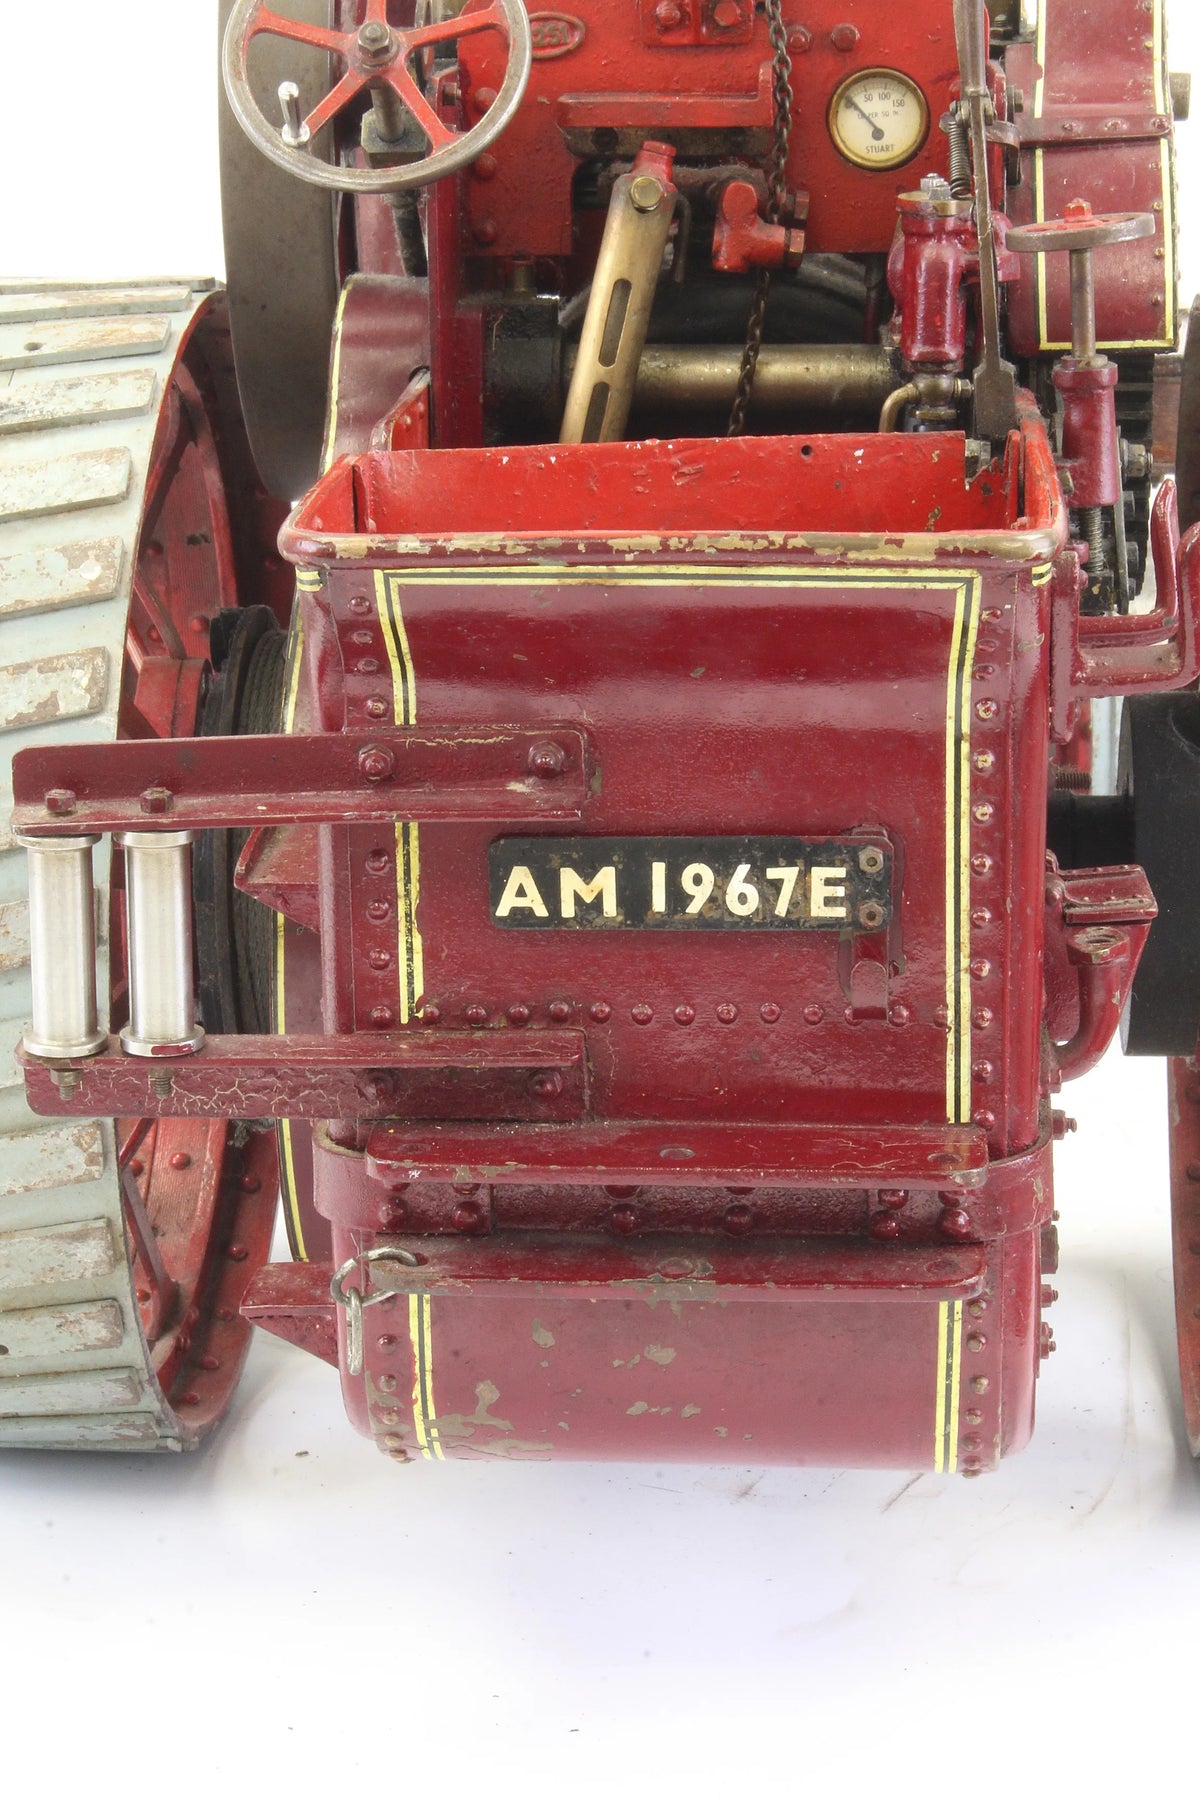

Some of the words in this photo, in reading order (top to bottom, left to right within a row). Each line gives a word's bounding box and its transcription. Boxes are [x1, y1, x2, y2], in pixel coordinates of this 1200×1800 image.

[864, 93, 873, 102] 50
[878, 92, 891, 101] 100
[892, 99, 905, 107] 150
[865, 144, 895, 154] STUART
[495, 865, 617, 918] AM
[651, 861, 847, 918] 1967E
